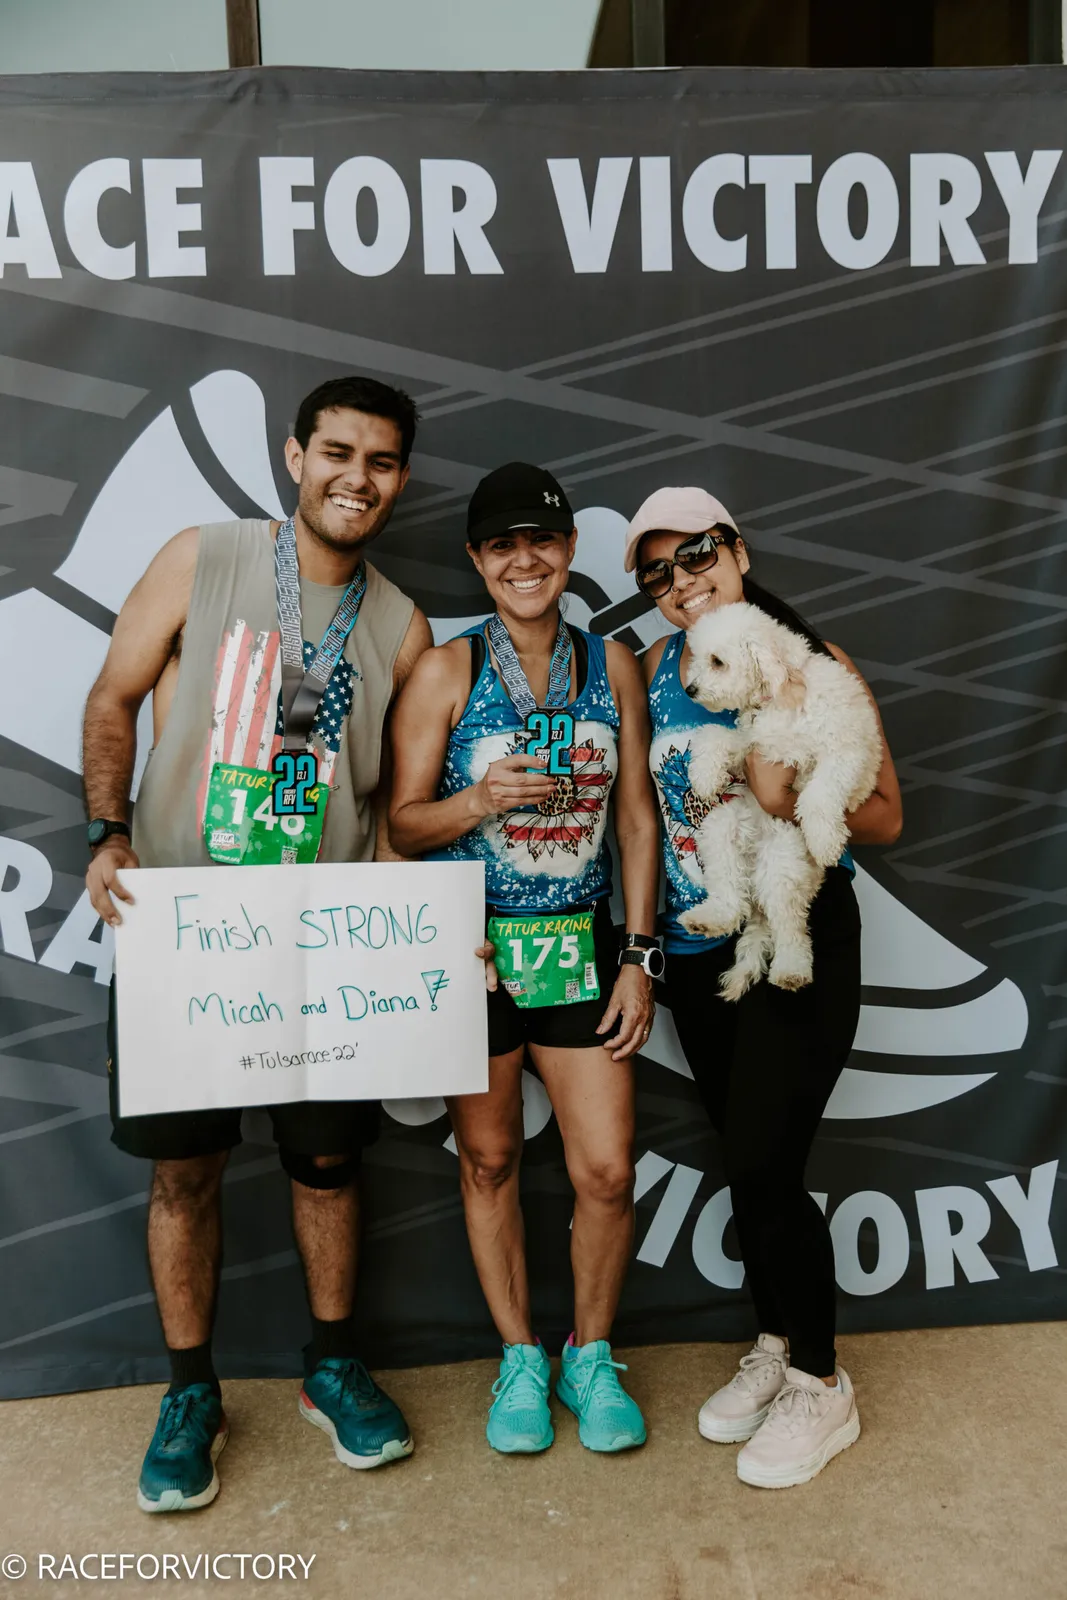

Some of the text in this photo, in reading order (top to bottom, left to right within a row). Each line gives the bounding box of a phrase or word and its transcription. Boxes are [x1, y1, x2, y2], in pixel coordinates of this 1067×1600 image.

[0, 150, 1063, 280] ACE FOR VICTORY
[278, 546, 299, 589] VICTORY
[332, 589, 360, 634] VICTORY
[281, 614, 302, 667] FINISHER
[323, 629, 346, 656] FOR
[309, 648, 338, 684] RACE
[526, 713, 573, 775] 22
[551, 730, 562, 740] 13.1
[220, 769, 266, 789] TATUR
[275, 754, 317, 814] 22
[296, 770, 307, 780] 13.1
[283, 794, 297, 805] RFV
[0, 835, 115, 987] RA
[174, 894, 438, 952] Finish STRONG
[497, 917, 592, 937] TATUR RACING
[508, 935, 580, 972] 175
[188, 991, 284, 1026] Micah
[301, 995, 327, 1015] and
[570, 1150, 1060, 1297] ICORY
